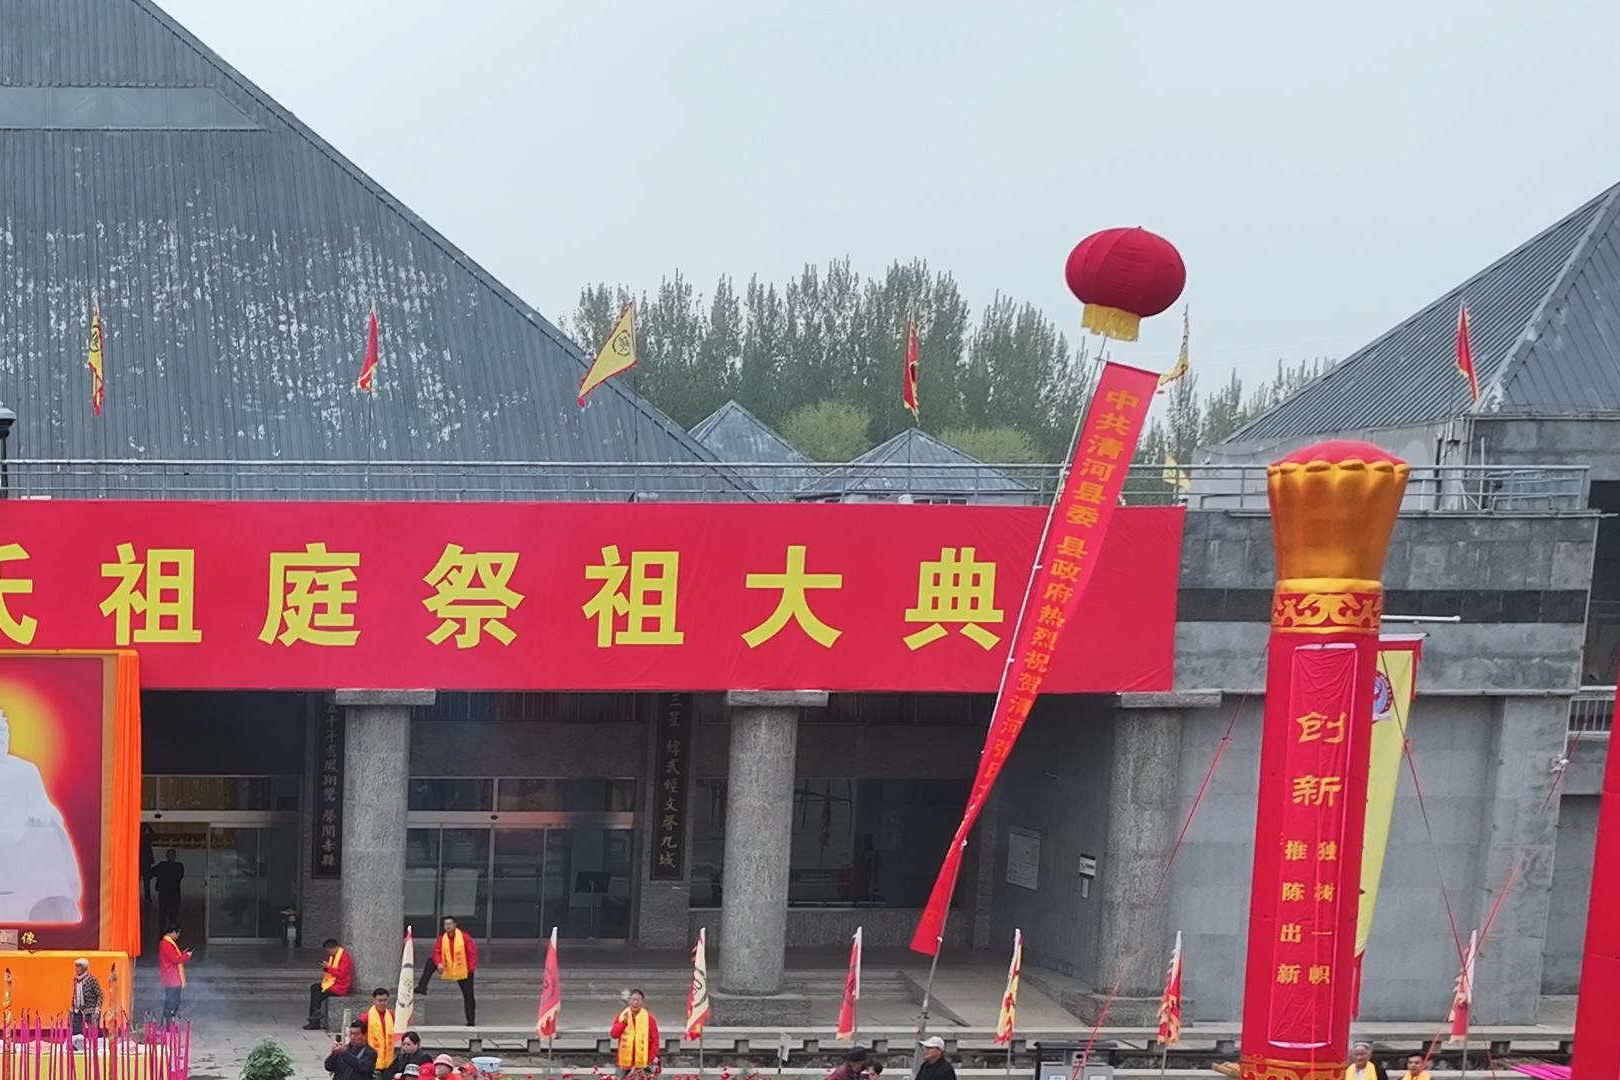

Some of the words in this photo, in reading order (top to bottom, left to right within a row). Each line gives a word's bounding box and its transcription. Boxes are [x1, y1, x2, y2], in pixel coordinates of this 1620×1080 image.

[1066, 389, 1140, 528] 中共清河县委
[1291, 711, 1347, 807] 创新
[1276, 841, 1307, 985] 推陈出新
[1308, 841, 1338, 985] 独树一帜
